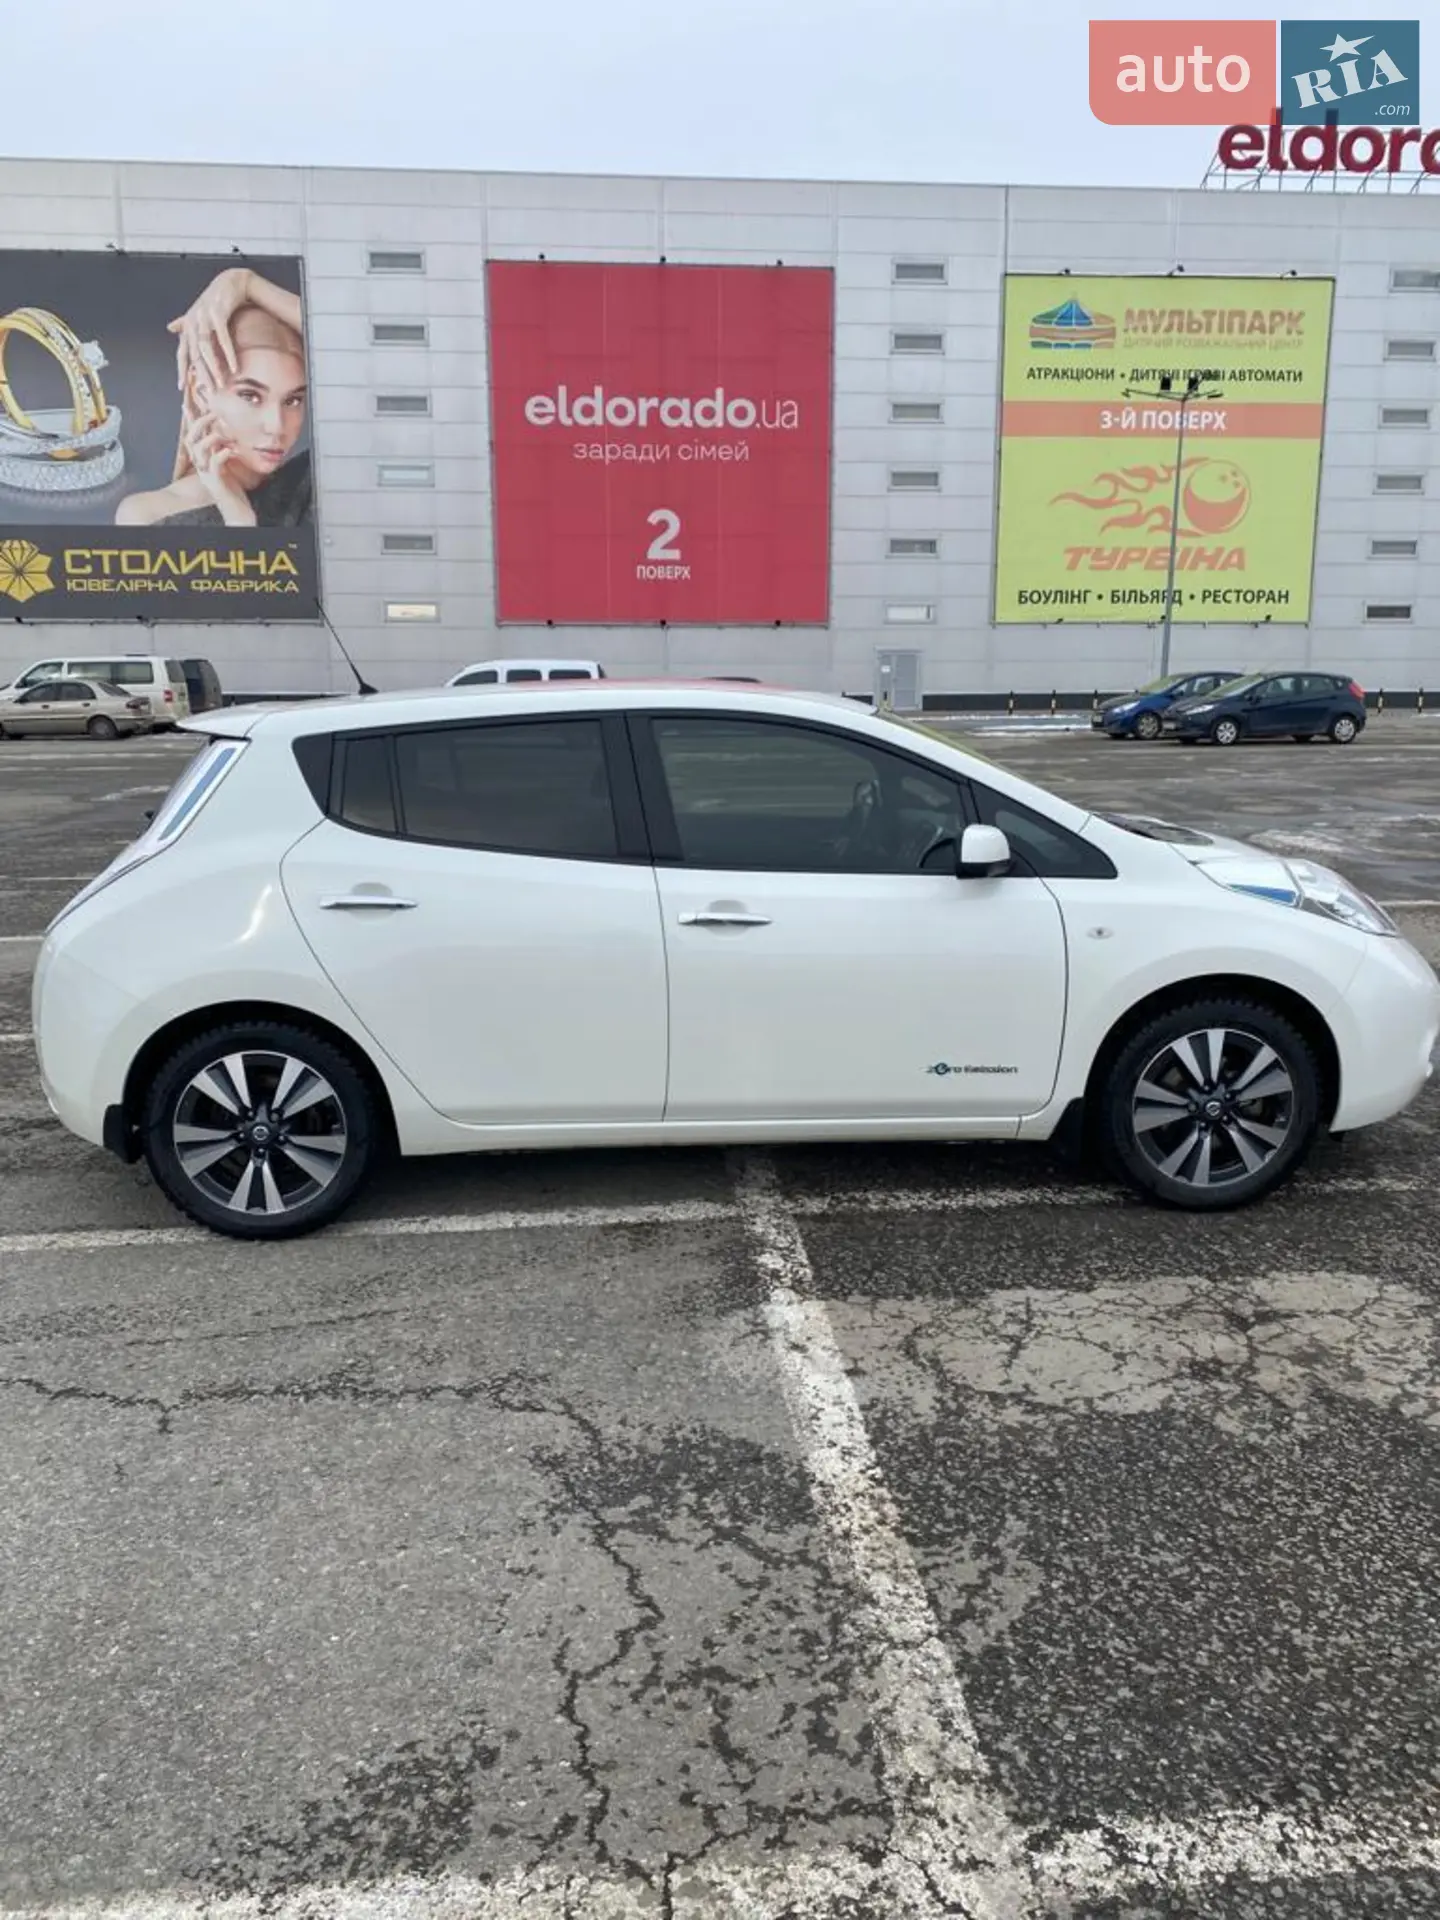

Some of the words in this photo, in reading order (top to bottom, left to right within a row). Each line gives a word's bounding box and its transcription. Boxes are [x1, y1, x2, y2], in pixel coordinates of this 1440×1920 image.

[1123, 308, 1305, 335] МУЛЬТІПАРК
[1026, 367, 1115, 382] АТРАКЦІОНИ
[1229, 369, 1303, 382] АВТОМАТИ
[525, 385, 799, 429] eldorado.ua
[1100, 407, 1137, 430] 3-Й
[1142, 409, 1228, 431] ПОВЕРХ
[573, 441, 671, 465] заради
[678, 438, 750, 461] сімей
[646, 509, 681, 560] 2
[64, 548, 299, 575] СТОЛИЧНА
[1063, 546, 1247, 571] ТУРБІНА
[637, 565, 691, 579] ПОВЕРХ
[67, 579, 179, 592] ЮВЕЛІРНА
[191, 579, 299, 593] ФАБРИКА
[1018, 589, 1092, 605] БОУЛІНГ
[1201, 590, 1290, 605] РЕСТОРАН
